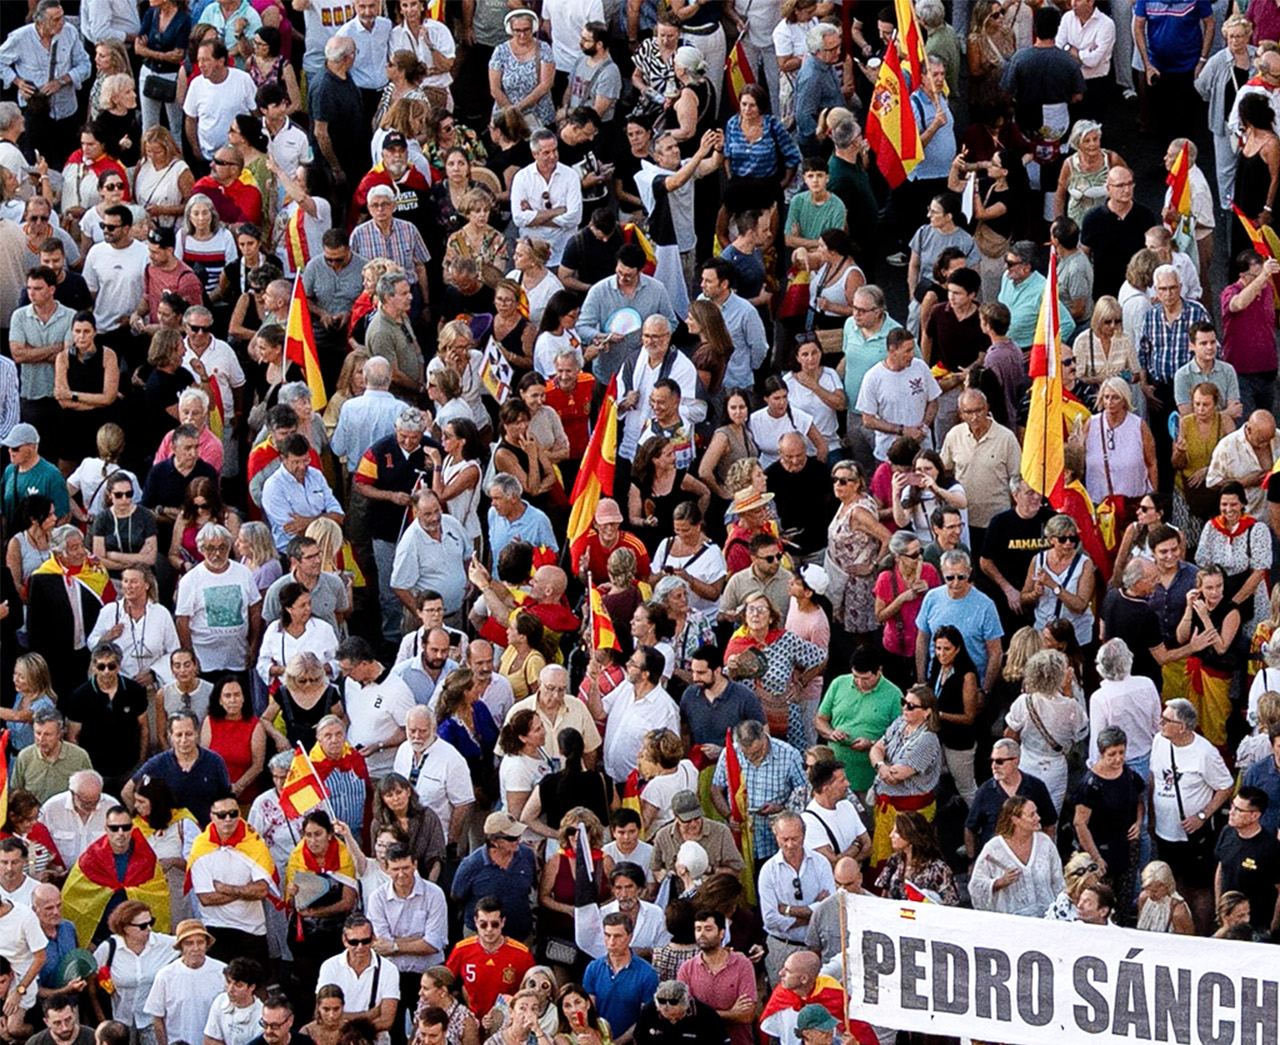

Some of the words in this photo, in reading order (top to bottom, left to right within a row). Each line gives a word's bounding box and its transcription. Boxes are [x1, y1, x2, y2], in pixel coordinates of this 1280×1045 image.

[385, 453, 394, 467] 1
[374, 699, 382, 709] 2
[465, 964, 476, 983] 5
[862, 931, 1054, 1027] PEDRO
